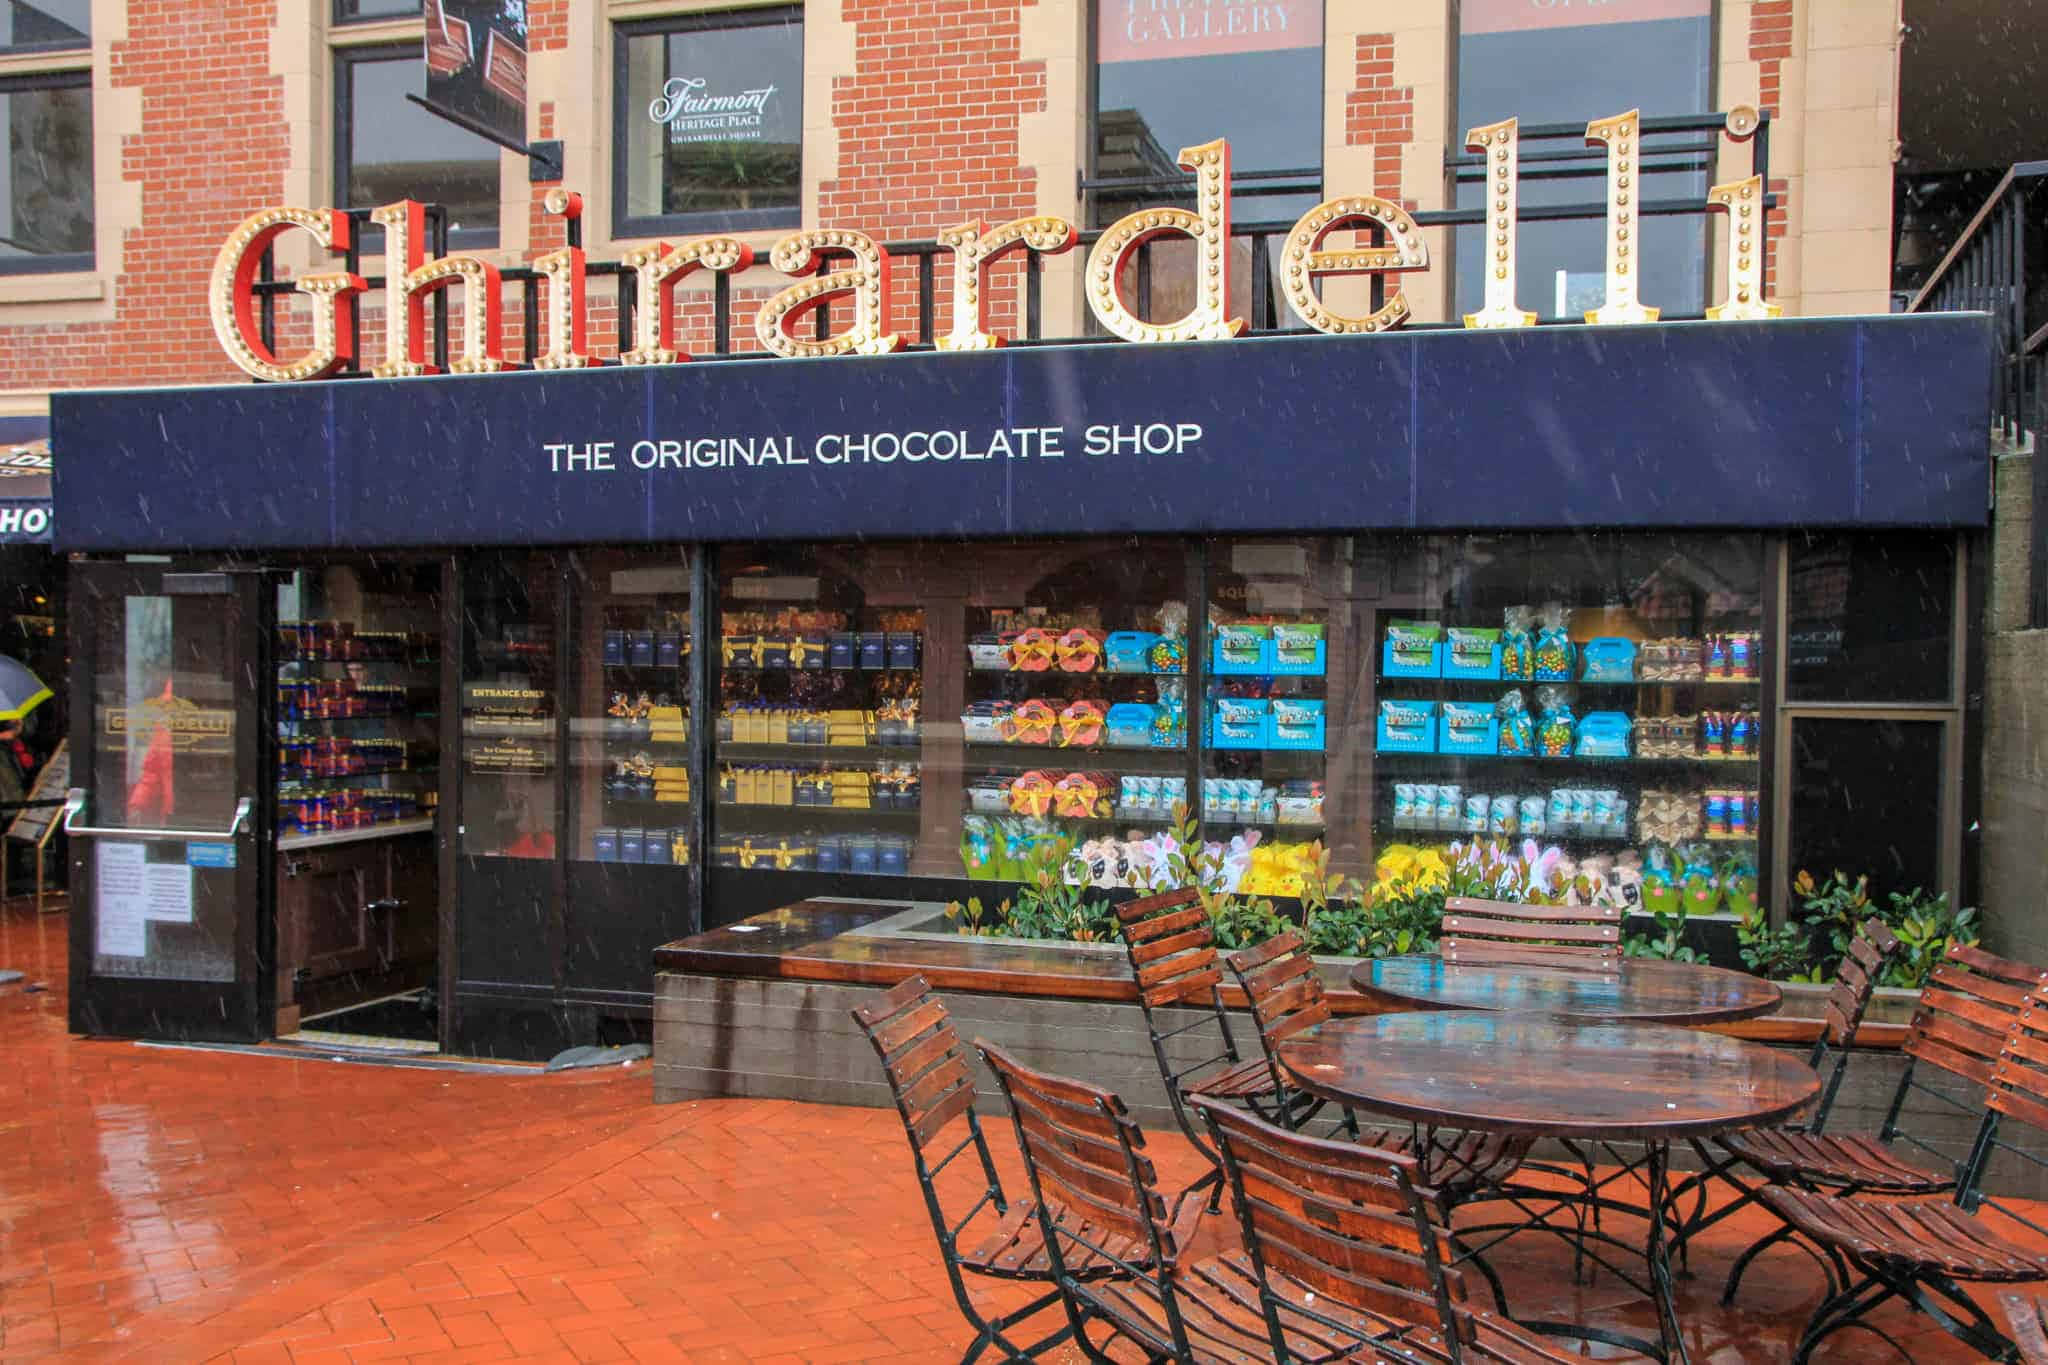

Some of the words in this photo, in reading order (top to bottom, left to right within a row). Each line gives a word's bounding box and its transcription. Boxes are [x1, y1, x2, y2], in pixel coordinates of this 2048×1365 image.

[1127, 4, 1289, 41] GALLERY
[649, 77, 778, 124] Fairmont
[671, 117, 725, 131] HERITAGE
[728, 114, 761, 127] PLACE
[208, 104, 1783, 382] Ghirardelli
[543, 442, 616, 472] THE
[631, 436, 809, 469] ORIGINAL
[815, 426, 1064, 464] CHOCOLATE
[1083, 423, 1202, 456] SHOP
[472, 688, 521, 698] ENTRANCE
